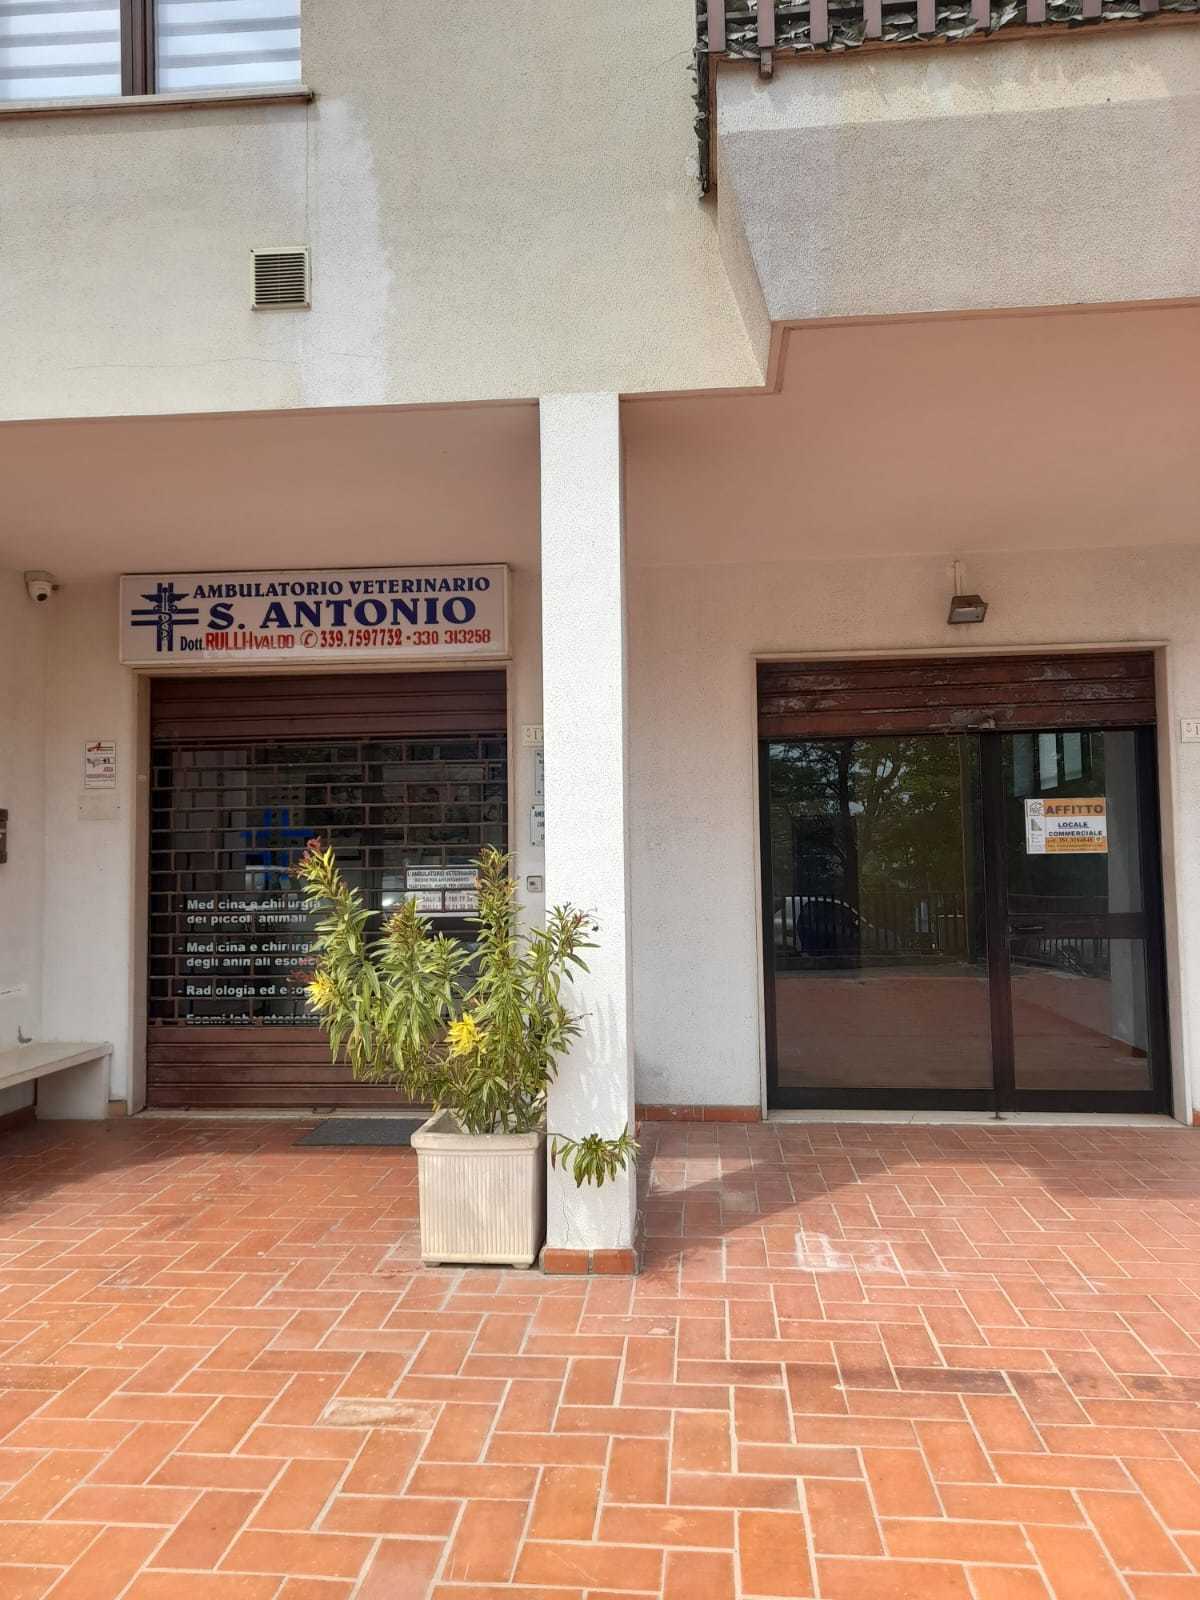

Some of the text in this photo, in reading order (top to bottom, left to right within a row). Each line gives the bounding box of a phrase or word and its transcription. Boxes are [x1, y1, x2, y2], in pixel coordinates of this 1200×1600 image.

[193, 577, 490, 599] AMBULATORIO VETERINARIO
[207, 596, 476, 630] S. ANTONIO
[444, 629, 491, 644] 313258
[1046, 804, 1104, 815] AFFITTO
[250, 943, 258, 952] e
[186, 985, 256, 998] Radologia
[259, 985, 276, 995] ed
